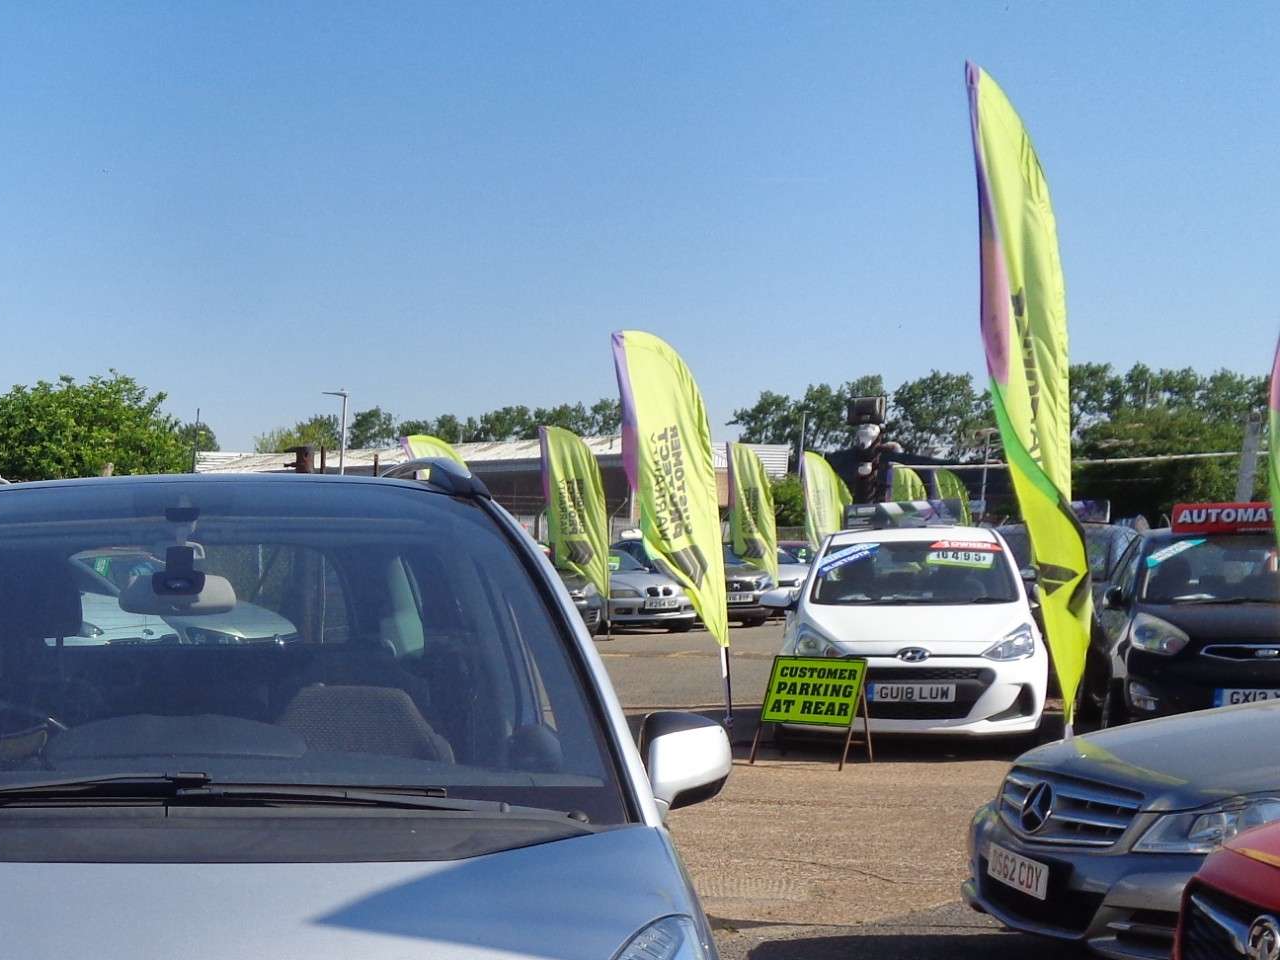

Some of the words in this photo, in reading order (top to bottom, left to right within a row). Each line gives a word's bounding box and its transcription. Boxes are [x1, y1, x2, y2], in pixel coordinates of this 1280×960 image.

[780, 666, 858, 681] CUSTOMER
[776, 681, 854, 698] PARKING
[879, 686, 915, 700] GU18
[920, 686, 950, 699] LUW
[770, 699, 795, 714] AT
[800, 700, 850, 717] REAR
[1018, 861, 1042, 892] CDY
